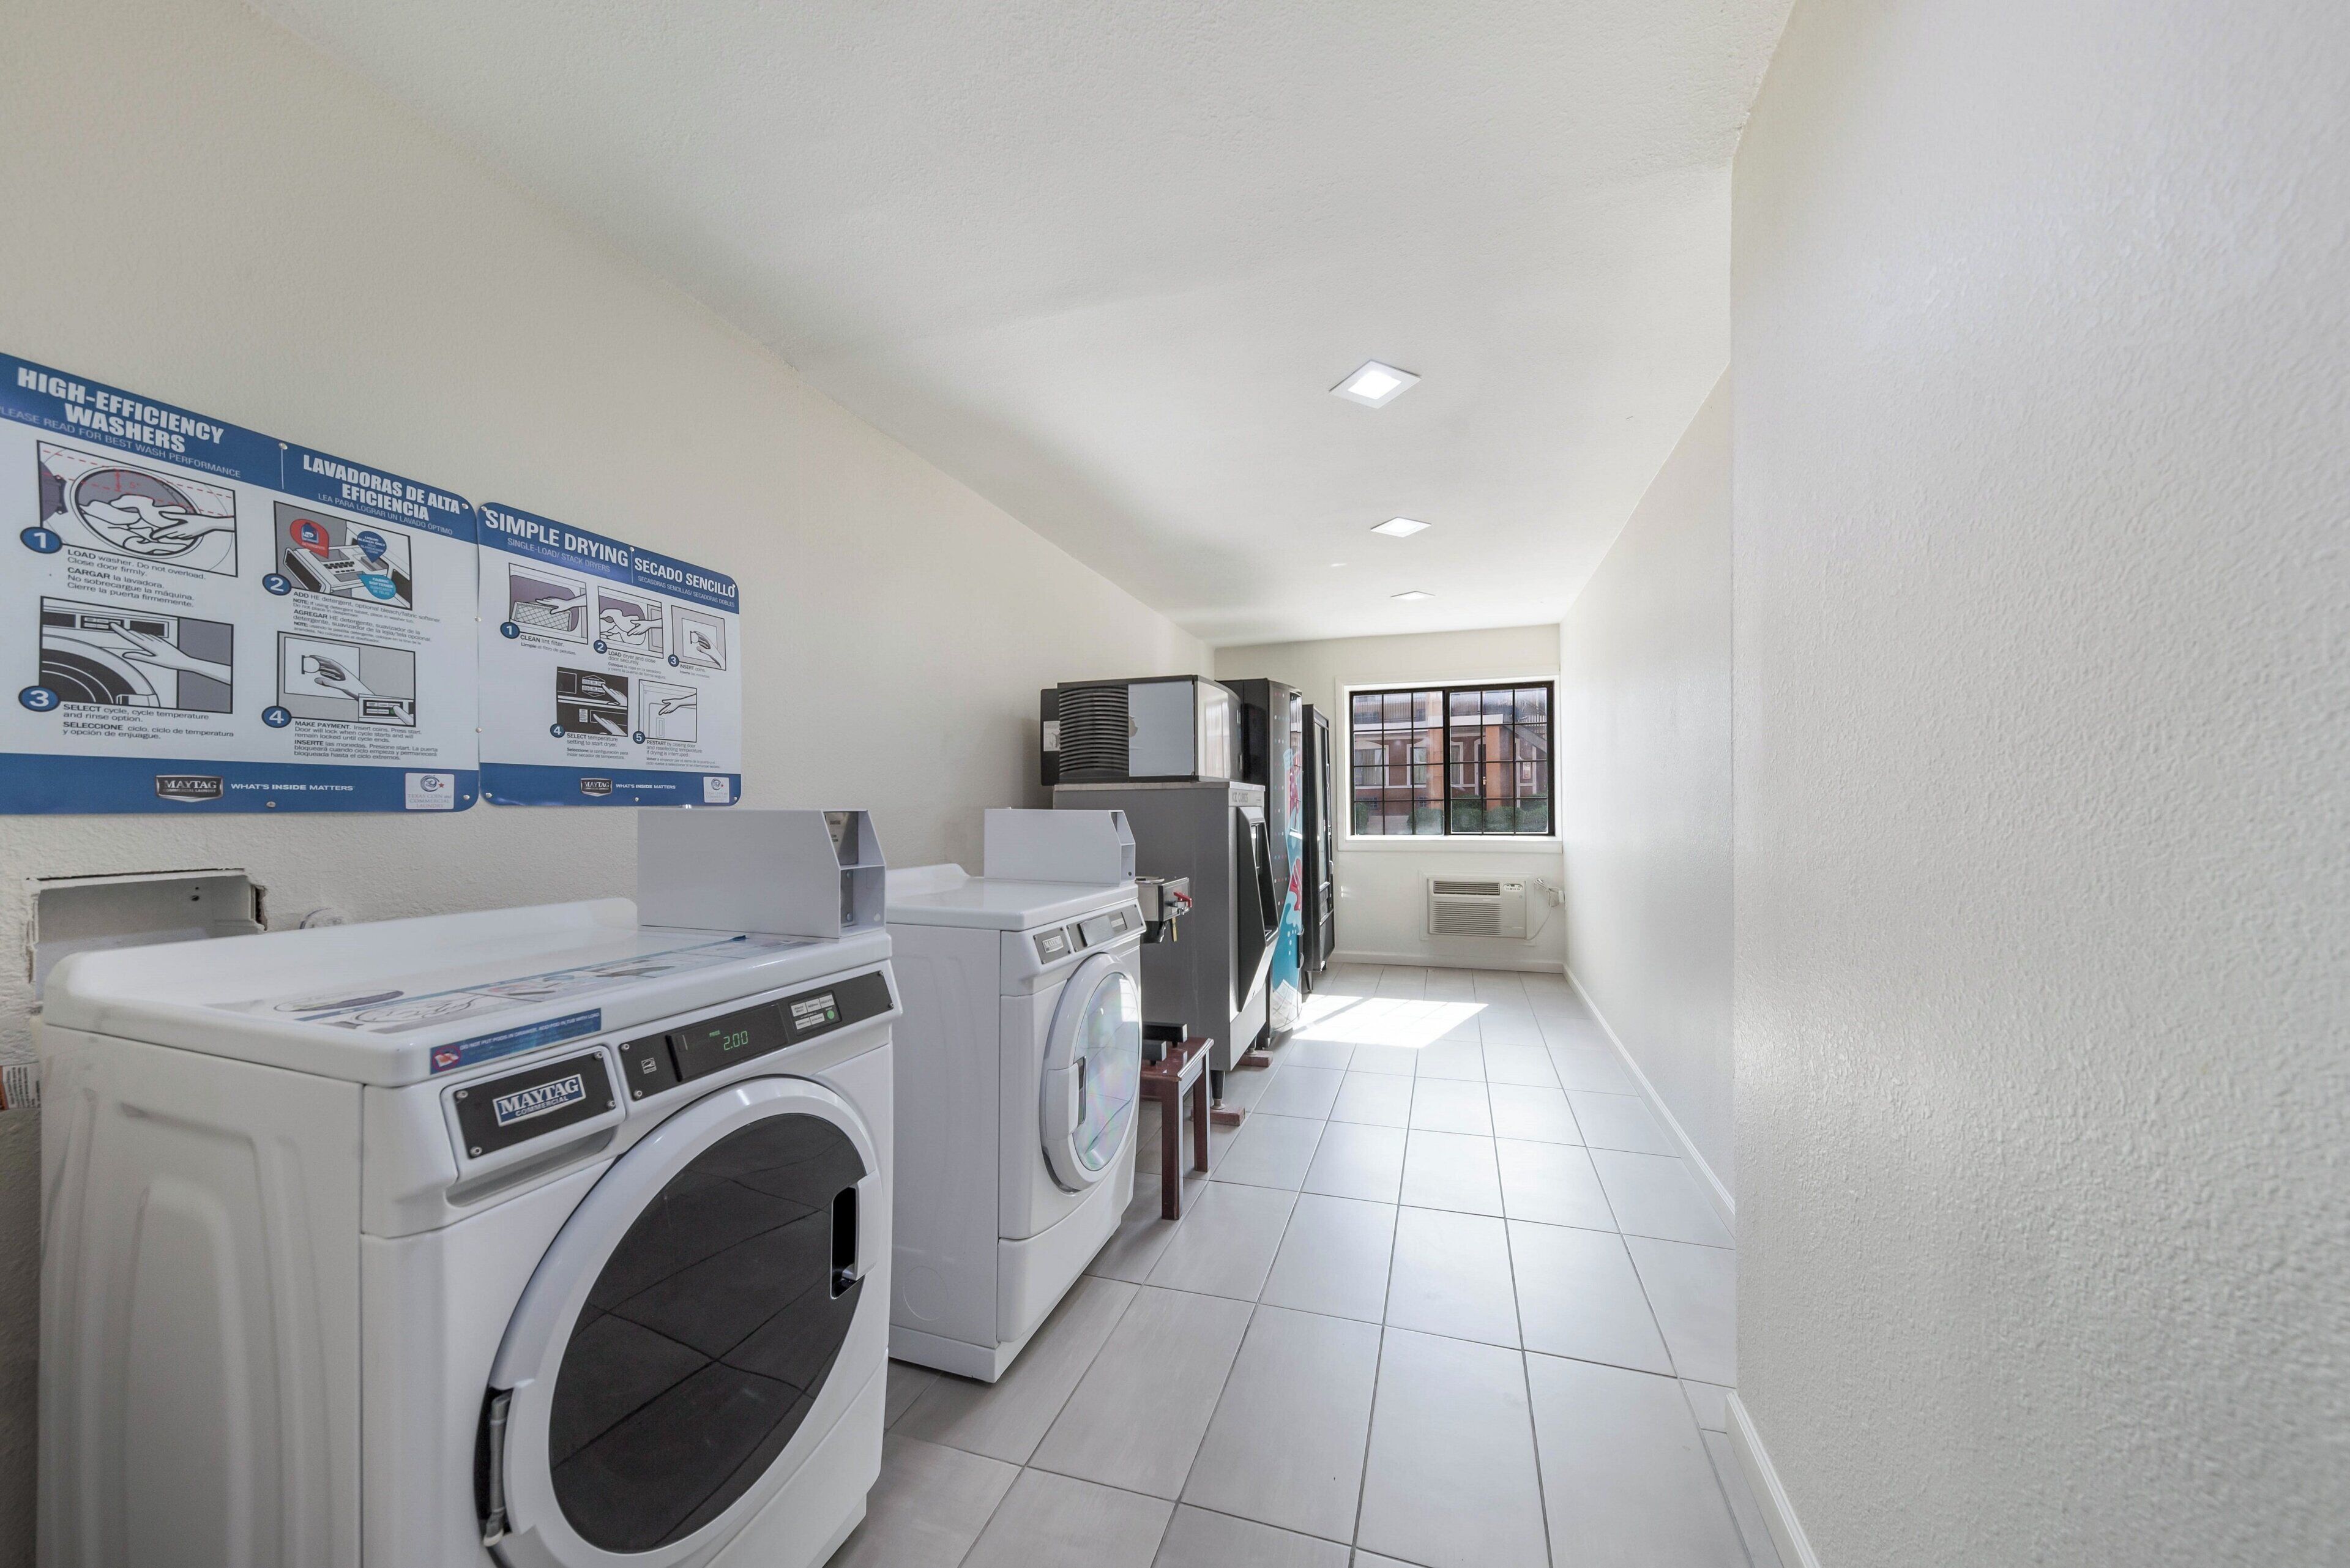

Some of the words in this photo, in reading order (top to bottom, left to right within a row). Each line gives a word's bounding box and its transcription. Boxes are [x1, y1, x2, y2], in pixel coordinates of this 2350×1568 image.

[18, 367, 224, 444] HIGH-EFFICIENCY
[65, 404, 185, 453] WASHERS
[0, 405, 40, 424] LEASE
[43, 417, 75, 433] READ
[79, 427, 102, 441] FOR
[105, 436, 131, 449] BEST
[136, 444, 166, 458] WASH
[170, 453, 241, 478] PERFORMANCE
[304, 455, 402, 496] LAVADORAS
[406, 485, 424, 502] DE
[428, 493, 460, 514] ALTA
[318, 493, 330, 502] LEA
[335, 497, 354, 509] PARA
[357, 504, 386, 517] LOGRAR
[388, 512, 398, 520] UN
[400, 515, 425, 528] LAVADO
[342, 483, 430, 521] EFICIENCIA
[34, 532, 46, 548] 1
[485, 510, 559, 547] SIMPLE
[565, 533, 628, 567] DRYING
[68, 550, 96, 559] LOAD
[99, 556, 134, 566] washer.
[168, 569, 206, 580] overload.
[508, 538, 559, 558] SINGLE-LOAD/
[561, 553, 583, 564] STACK
[585, 559, 610, 573] DRYERS
[68, 557, 94, 566] Close
[121, 566, 147, 577] firmly.
[68, 567, 110, 579] CARGAR
[124, 577, 164, 589] lavadora.
[270, 577, 284, 592] 2
[635, 558, 682, 583] SECADO
[686, 573, 734, 598] SENCILLO
[68, 582, 96, 592] Cierre
[110, 589, 140, 599] puerta
[142, 594, 193, 607] firmemente.
[84, 578, 142, 592] sobrecargue
[155, 590, 195, 600] máquina.
[693, 592, 718, 602] SECADORAS
[355, 603, 379, 611] optional
[294, 609, 327, 619] AGREGAR
[376, 624, 406, 632] suavizador
[332, 622, 365, 631] suavizador
[507, 625, 512, 635] 1
[597, 643, 604, 651] 2
[671, 656, 676, 665] 3
[29, 690, 49, 707] 3
[63, 722, 123, 730] SELECCIONE
[157, 711, 209, 720] temperature
[269, 710, 284, 723] 4
[554, 726, 561, 734] 4
[723, 1030, 748, 1051] 2.00
[498, 1078, 579, 1115] MAYTAG
[515, 1096, 569, 1117] COMMERCIAL
